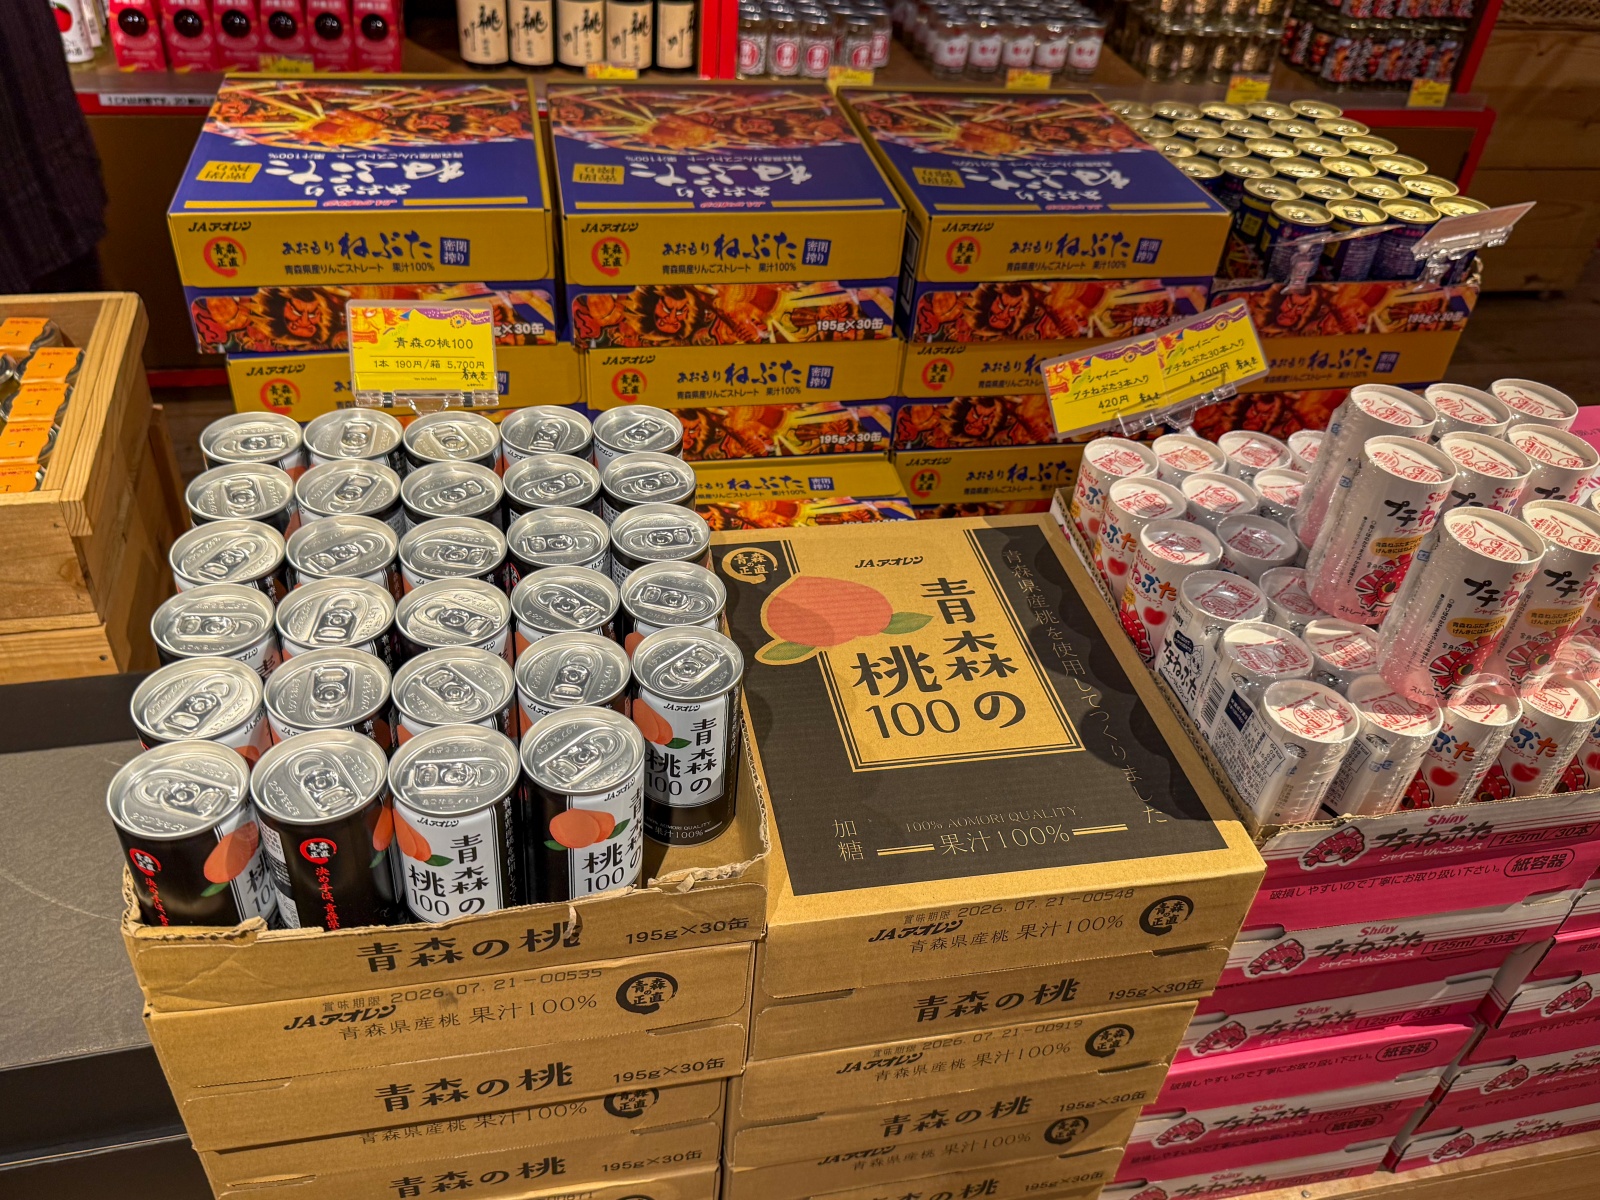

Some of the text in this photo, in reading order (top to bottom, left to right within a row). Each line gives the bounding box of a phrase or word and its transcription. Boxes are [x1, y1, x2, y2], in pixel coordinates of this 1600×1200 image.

[265, 159, 465, 185] ねぶた
[629, 162, 812, 187] ねぶた
[960, 167, 1130, 190] ねぶた
[304, 183, 411, 197] あおもり
[188, 221, 252, 234] JAアオレン
[581, 222, 639, 234] JAアオレン
[942, 221, 994, 233] JAアオレン
[282, 230, 434, 260] あおもり ねぶた
[662, 231, 797, 260] あおもり ねぶた
[1055, 231, 1131, 258] ねぶた
[284, 261, 435, 275] 青森県産りんごストレート 果汁100%
[662, 261, 797, 275] 青森県産りんごストレート 果汁100%
[816, 317, 885, 333] 195g×30缶
[394, 337, 474, 350] 青森の桃100
[1180, 335, 1220, 354] シャイニー
[246, 363, 306, 376] JAアオレン
[602, 354, 656, 366] JAアオレン
[677, 360, 802, 386] あおもり ねぶた
[1087, 367, 1128, 383] シャイニー
[766, 386, 802, 396] 果汁100%
[1098, 395, 1130, 410] 420円
[819, 431, 882, 446] 195g×30缶
[727, 474, 804, 492] ねぶた
[1006, 461, 1073, 483] ねぶた
[733, 552, 768, 565] 青森
[855, 555, 924, 569] JAアオレン
[738, 564, 770, 576] 正直
[905, 804, 1078, 834] 100% AOMORI QUALITY
[1424, 812, 1470, 828] Shiny
[939, 823, 1071, 857] 果汁100%
[1374, 821, 1496, 853] プチねぶた
[1498, 823, 1595, 847] 125ml/30本
[1379, 842, 1484, 862] シャイニーりんごジュース
[1510, 853, 1569, 873] 紙容器
[1269, 864, 1501, 901] 破損しやすいので丁寧にお取り扱い下さい。
[903, 909, 951, 924] 賞味期限
[625, 917, 751, 946] 195g×30缶
[868, 919, 965, 943] JAアオレン
[909, 914, 1125, 955] 青森県産桃 果汁100%
[1357, 924, 1400, 938] Shiny
[1430, 930, 1521, 952] 125ml/30本
[1314, 930, 1426, 960] プチねぶた
[1318, 949, 1415, 969] シャイニーりんごジュース
[322, 995, 382, 1014] 賞味期限
[911, 977, 1206, 1024] 青森の桃 195g×30缶
[1296, 1005, 1332, 1018] Shiny
[283, 1003, 397, 1032] JAアオレン
[337, 993, 599, 1042] 青森県産桃 果汁100%
[1255, 1009, 1358, 1036] プチねぶた
[1382, 1041, 1433, 1060] 紙容器
[836, 1051, 924, 1075] JAアオレン
[874, 1041, 1072, 1083] 青森県産桃 果汁100%
[373, 1056, 727, 1114] 青森の桃 195g×30缶
[880, 1088, 1148, 1138] 青森の桃 195g×30缶
[1250, 1103, 1287, 1115] Shiny
[358, 1100, 589, 1146] 青森県産桃 果汁100%
[942, 1131, 1032, 1158] 果汁100%
[388, 1149, 704, 1199] 青森の桃 195g×30缶
[1023, 1170, 1105, 1193] 195g×30缶
